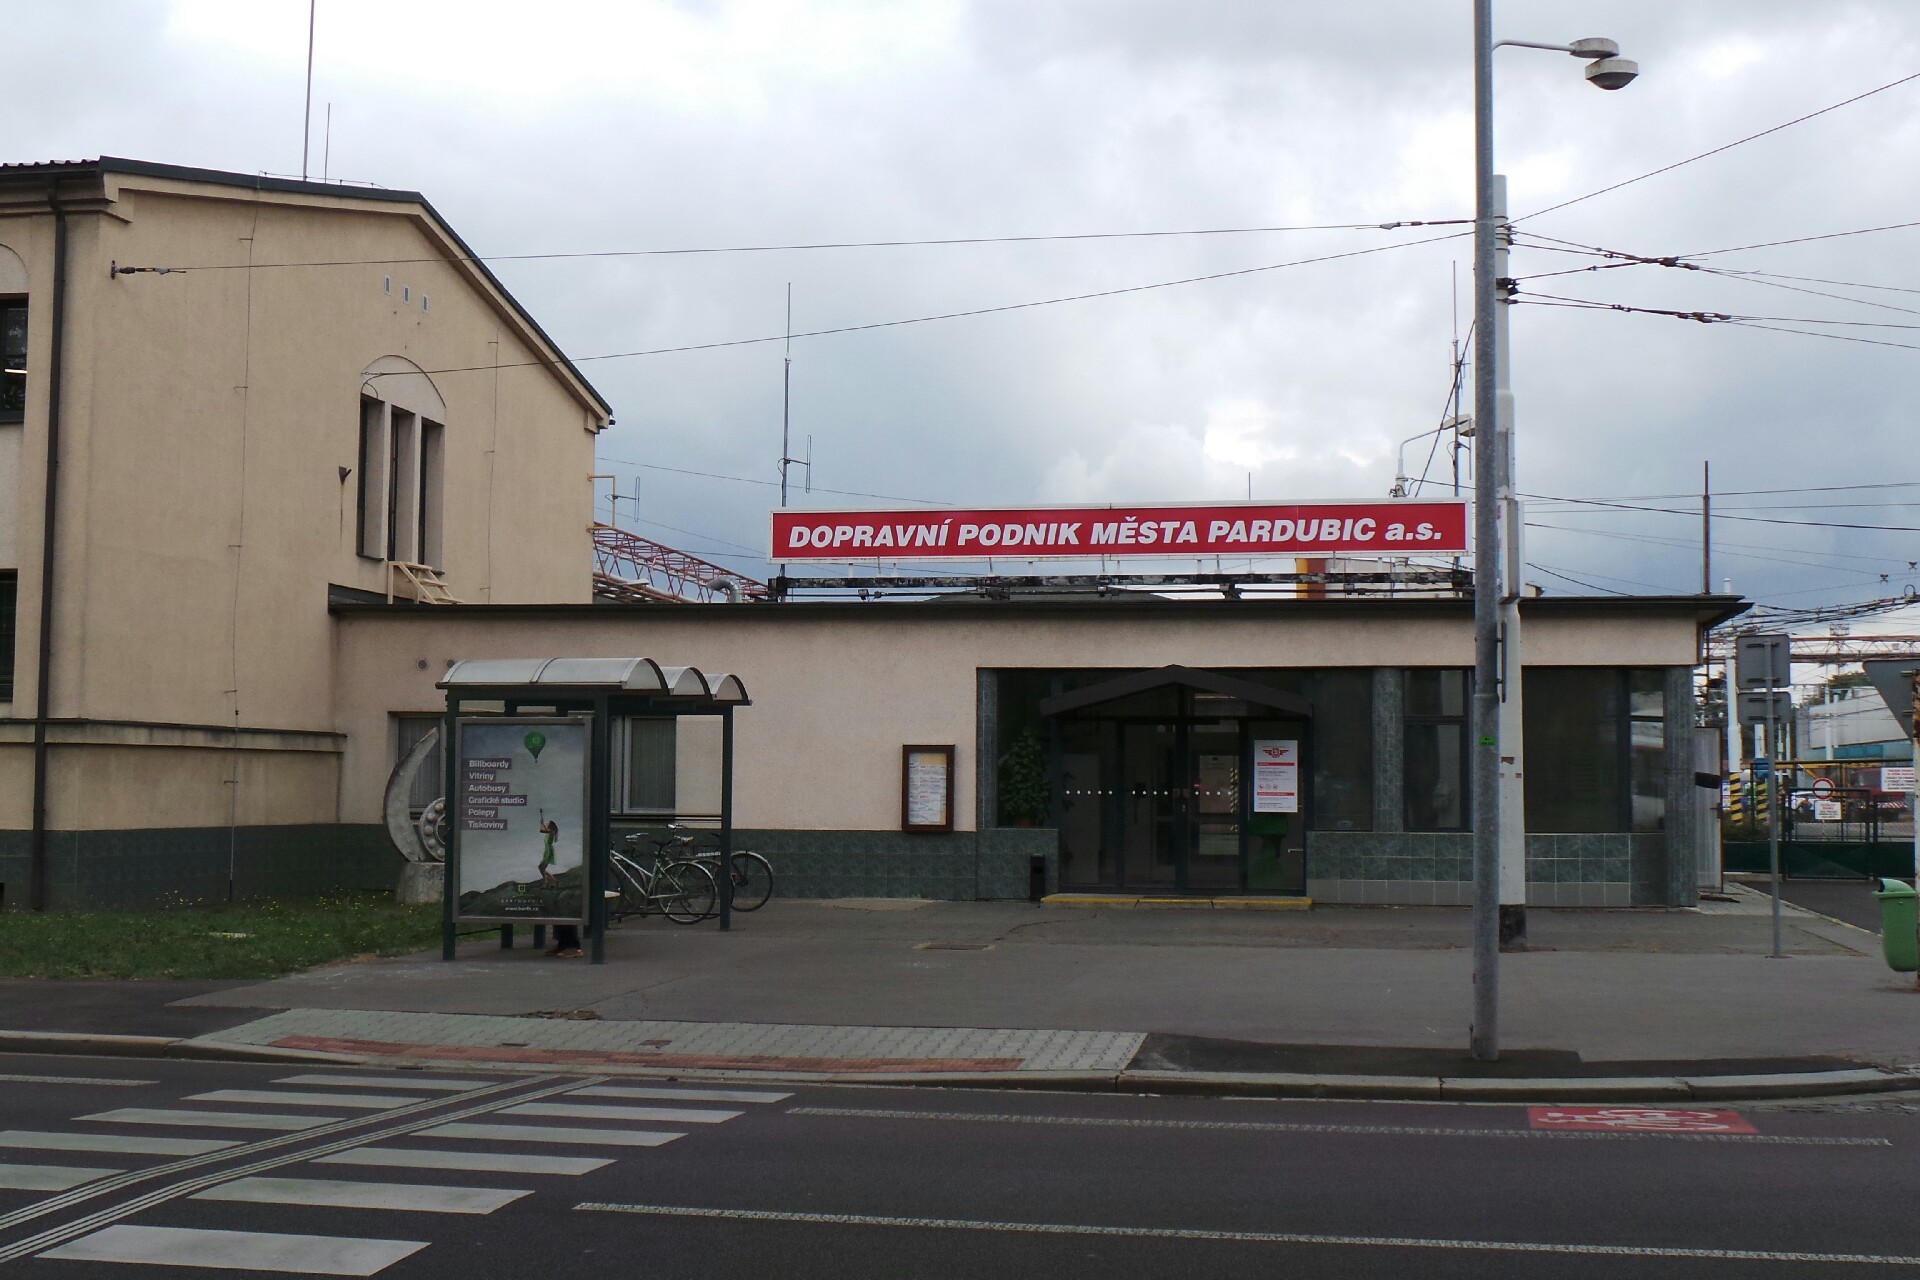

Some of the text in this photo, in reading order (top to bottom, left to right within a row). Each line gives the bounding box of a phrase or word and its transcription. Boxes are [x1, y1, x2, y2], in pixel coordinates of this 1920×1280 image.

[788, 515, 1443, 549] DOPRAVNÍ PODNIK MĚSTA PARDUBIC a.s.
[469, 759, 509, 769] Billboardy
[469, 772, 494, 781] Vitriny
[468, 784, 506, 793] Autobusy
[468, 796, 499, 804] Grafické
[468, 809, 495, 817] Polepy
[467, 821, 505, 830] Tiskoviny
